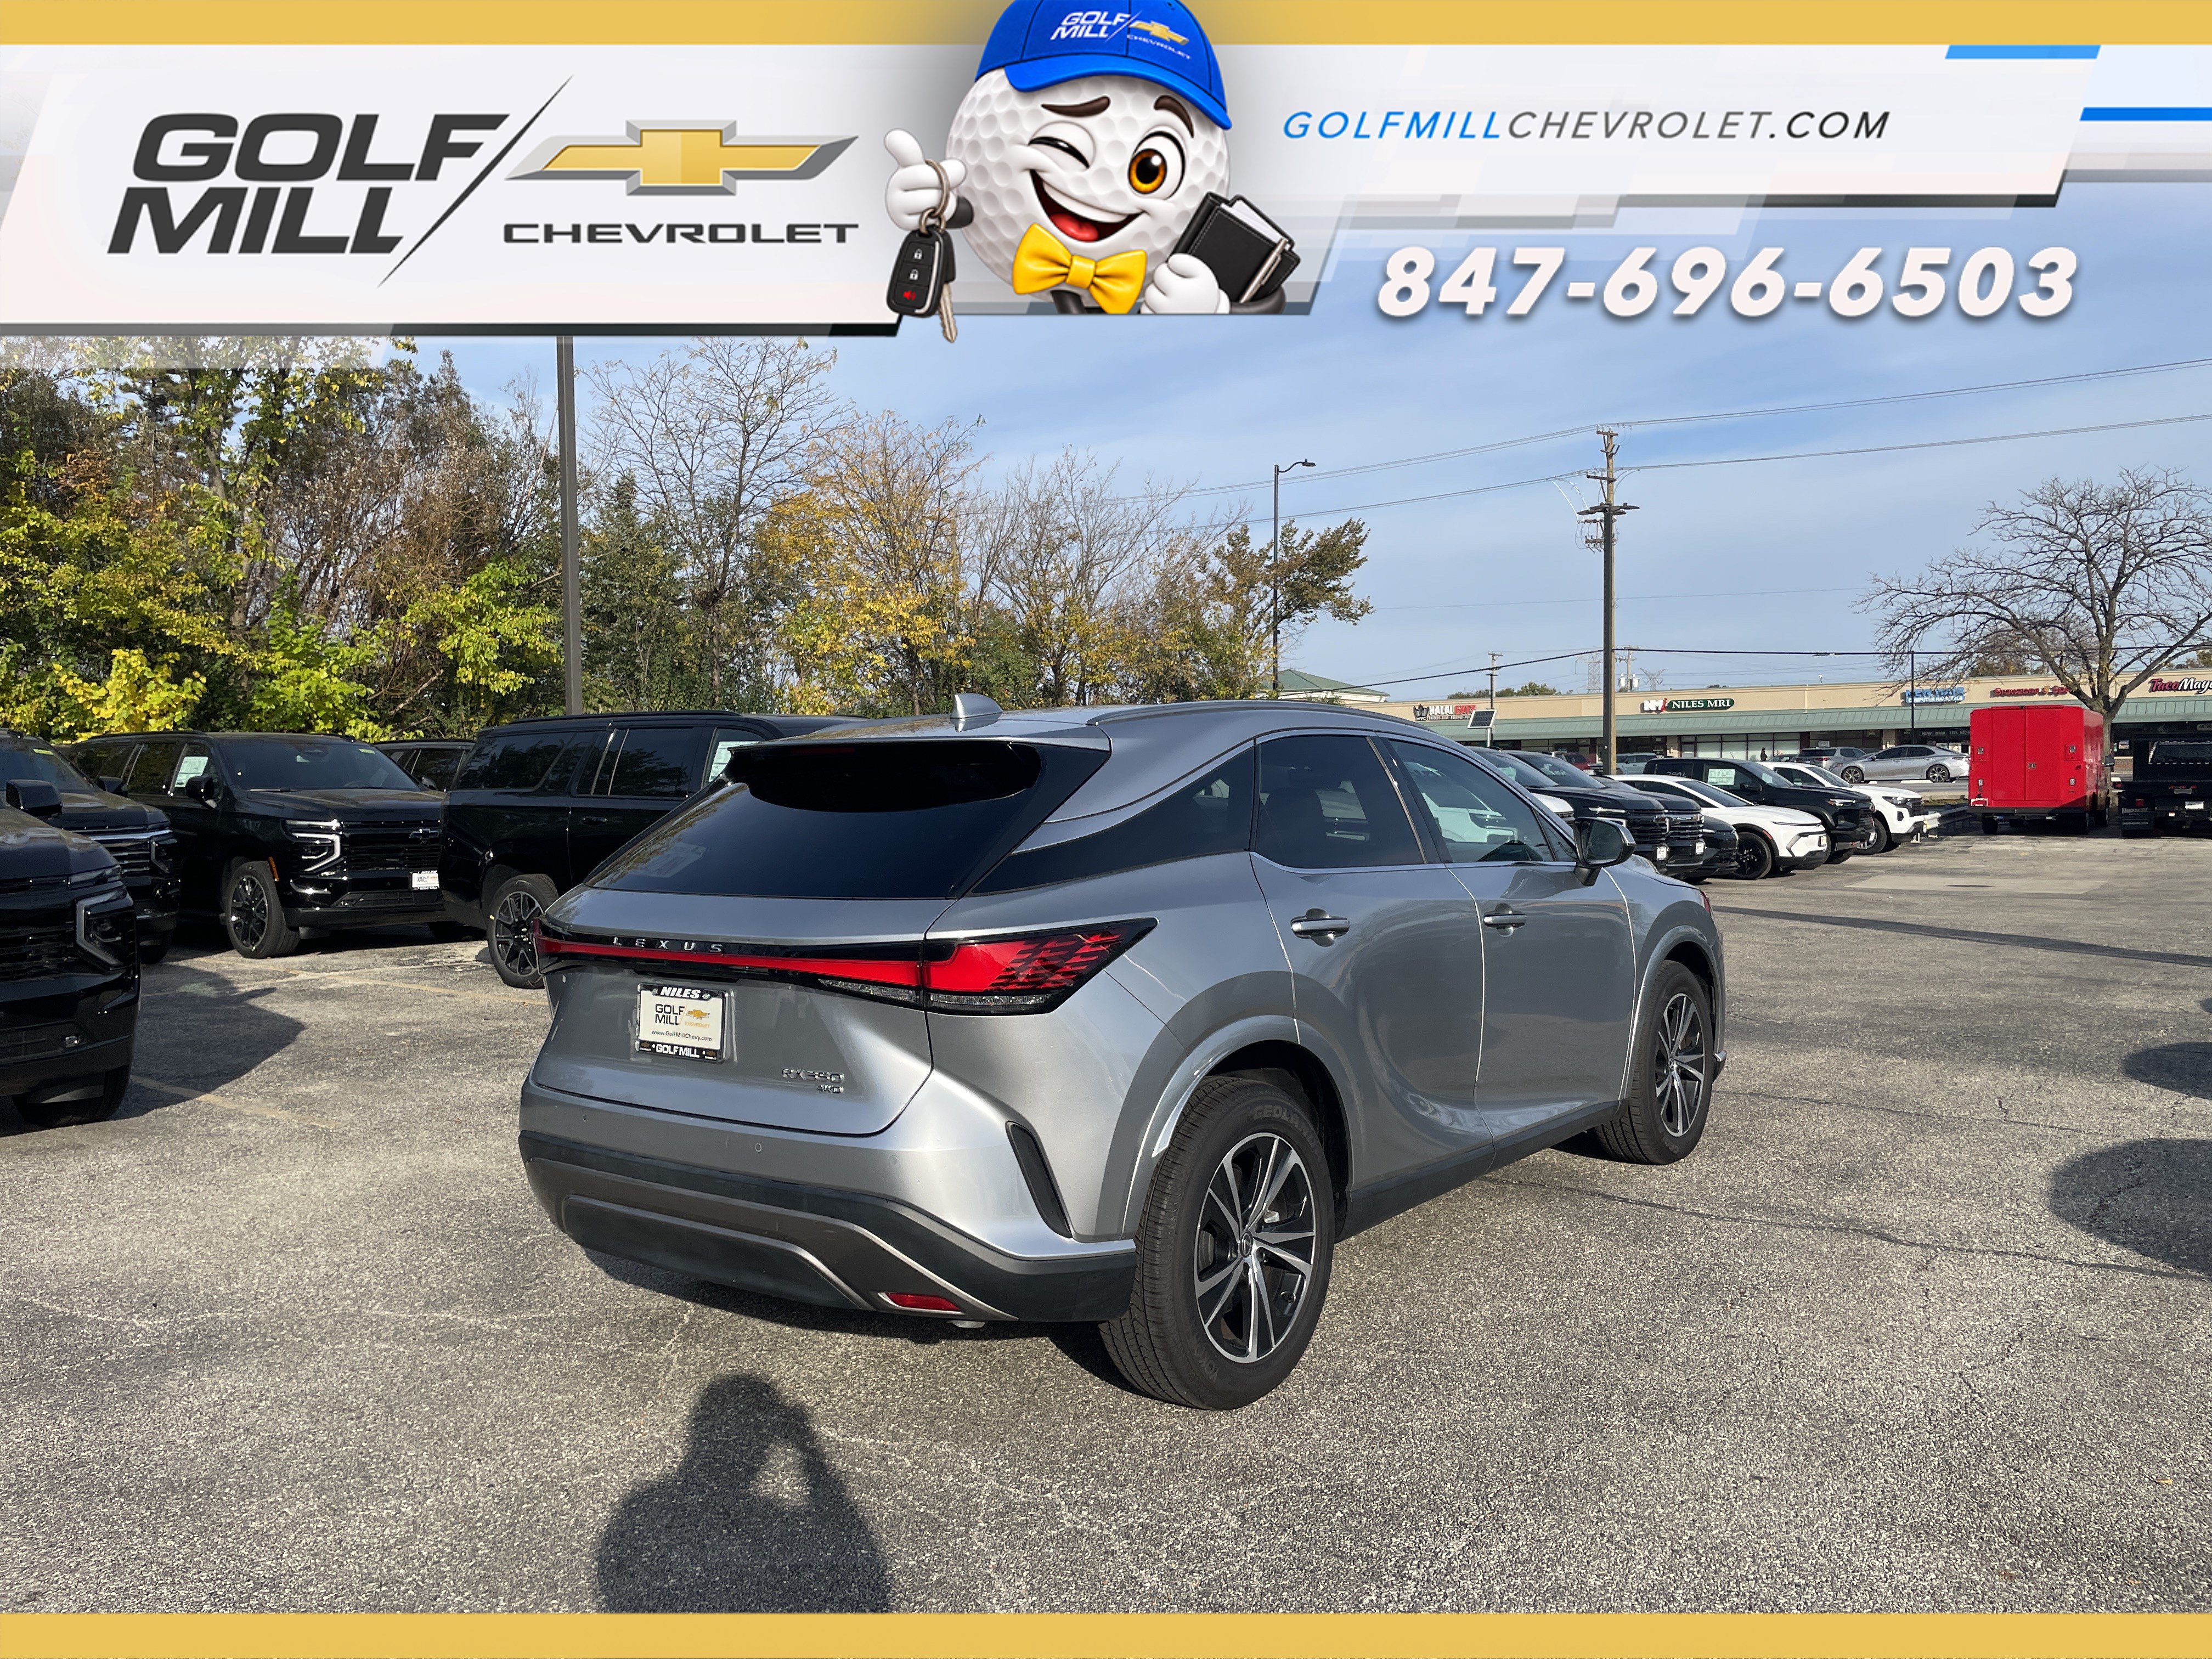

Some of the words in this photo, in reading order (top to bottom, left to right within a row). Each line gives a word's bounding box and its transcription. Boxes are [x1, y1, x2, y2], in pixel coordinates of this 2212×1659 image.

[1429, 705, 1454, 715] HALAL
[613, 936, 723, 953] LEXUS
[660, 986, 701, 998] NILES
[655, 1003, 685, 1015] GOLF
[655, 1014, 679, 1025] MILL
[652, 1030, 712, 1042] www.GolfMillChevy.com
[656, 1043, 679, 1055] GOLF
[679, 1046, 700, 1058] MILL
